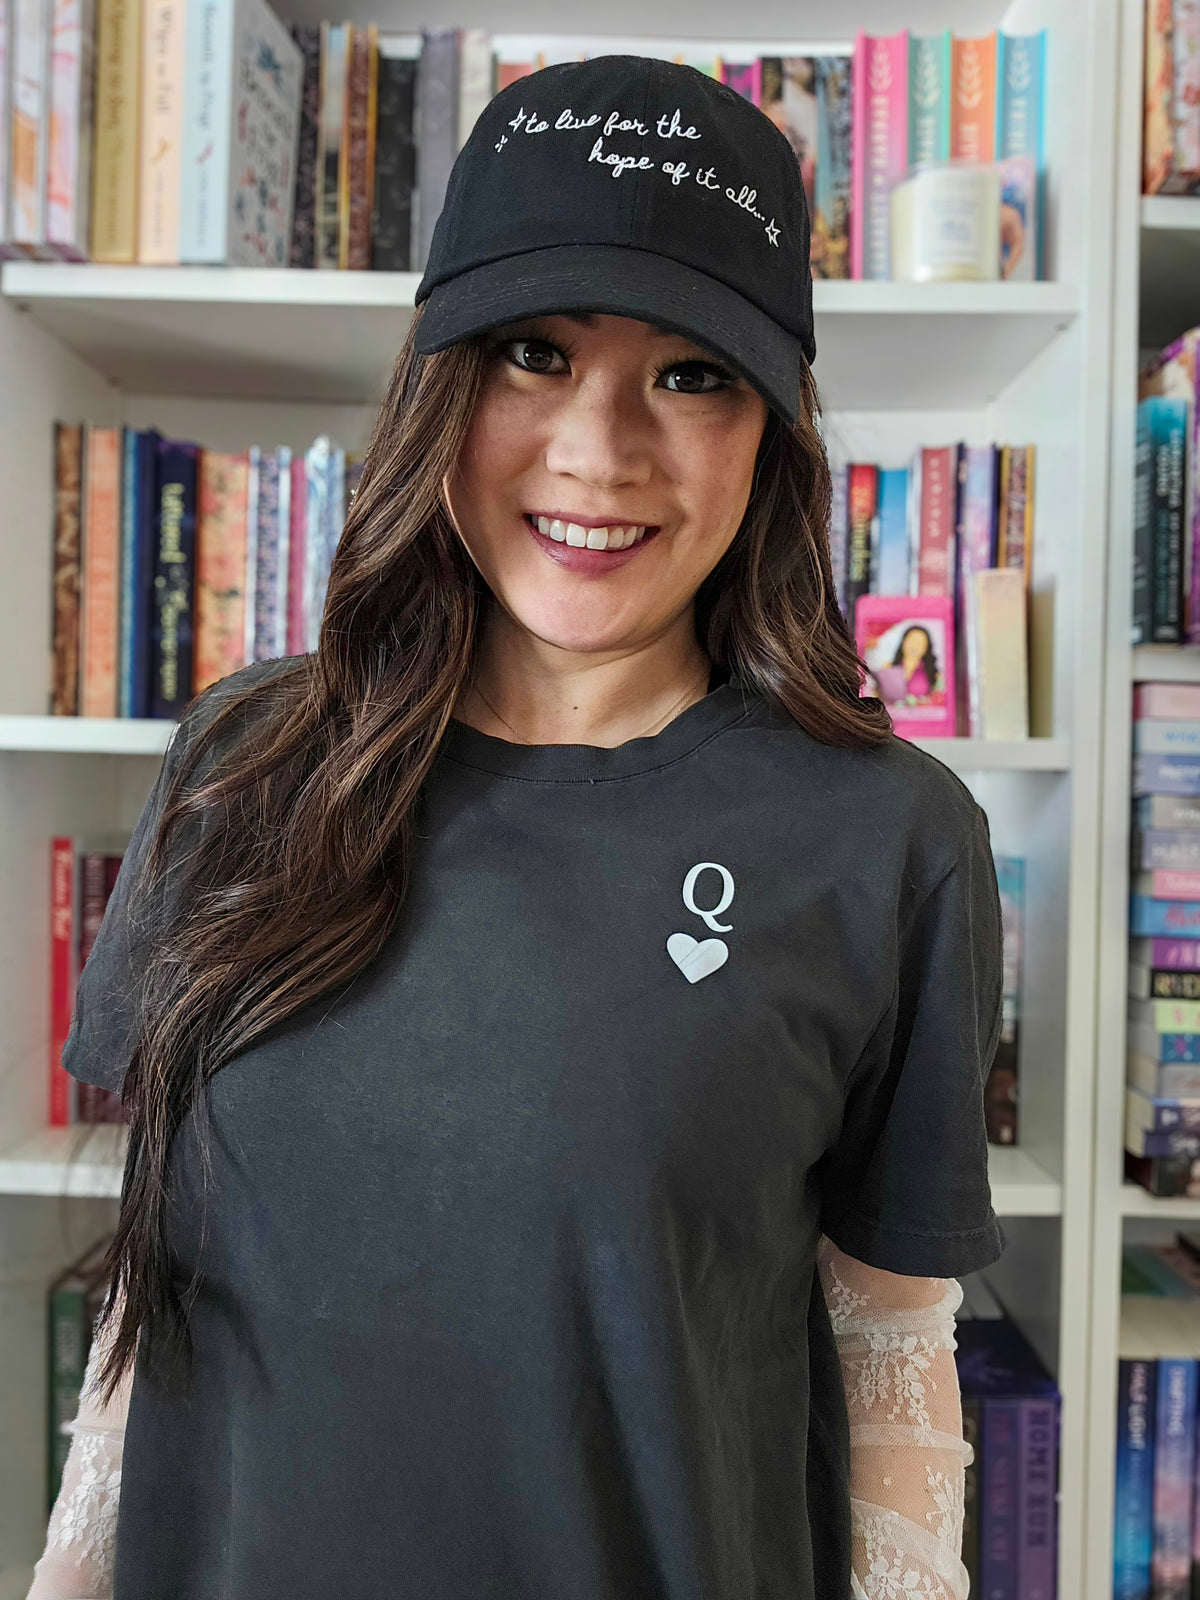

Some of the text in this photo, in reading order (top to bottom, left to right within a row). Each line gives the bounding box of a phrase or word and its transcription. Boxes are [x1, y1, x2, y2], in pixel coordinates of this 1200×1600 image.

[525, 108, 702, 140] to live for the
[587, 136, 655, 178] hope
[662, 161, 691, 186] of
[696, 167, 721, 190] it
[682, 862, 735, 933] Q
[1026, 1409, 1050, 1547] HOME RUN
